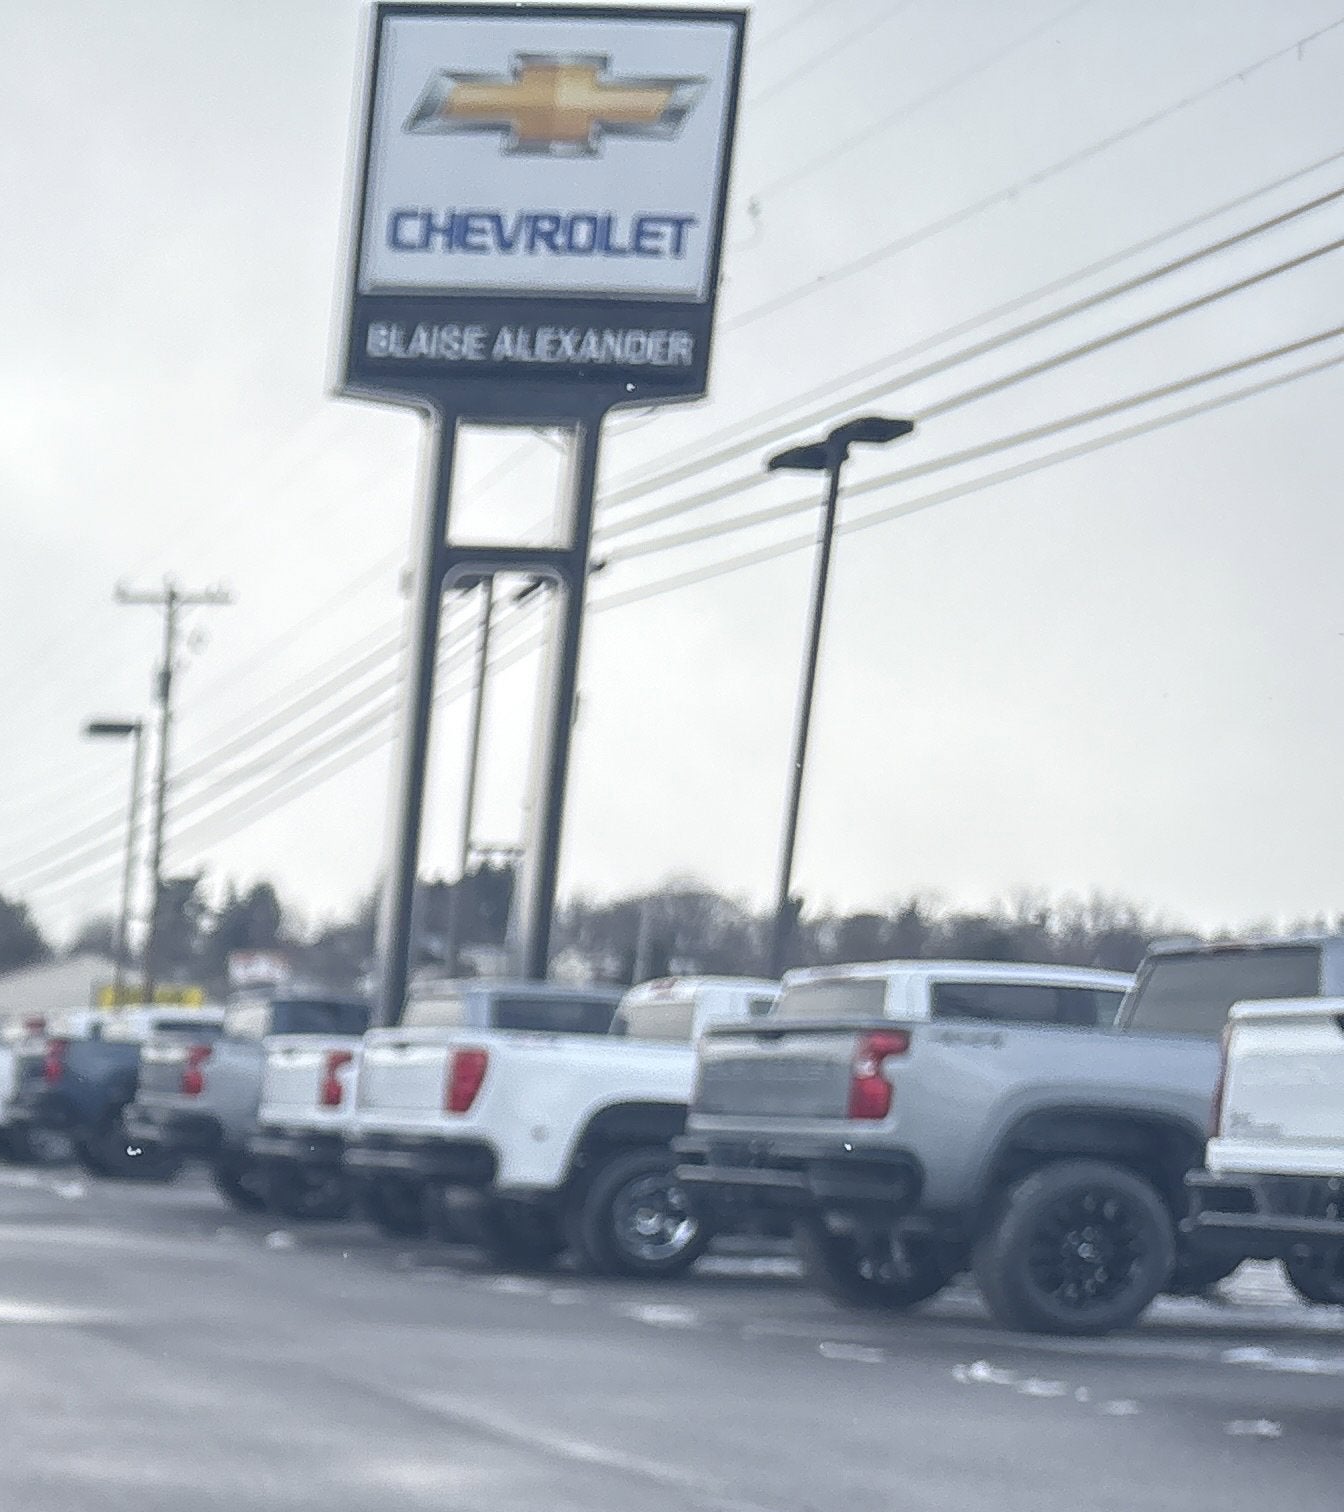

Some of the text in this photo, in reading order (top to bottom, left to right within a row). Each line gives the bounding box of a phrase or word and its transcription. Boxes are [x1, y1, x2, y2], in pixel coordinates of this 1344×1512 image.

[389, 208, 696, 257] CHEVROLET
[366, 321, 694, 366] BLAISE ALEXANDER
